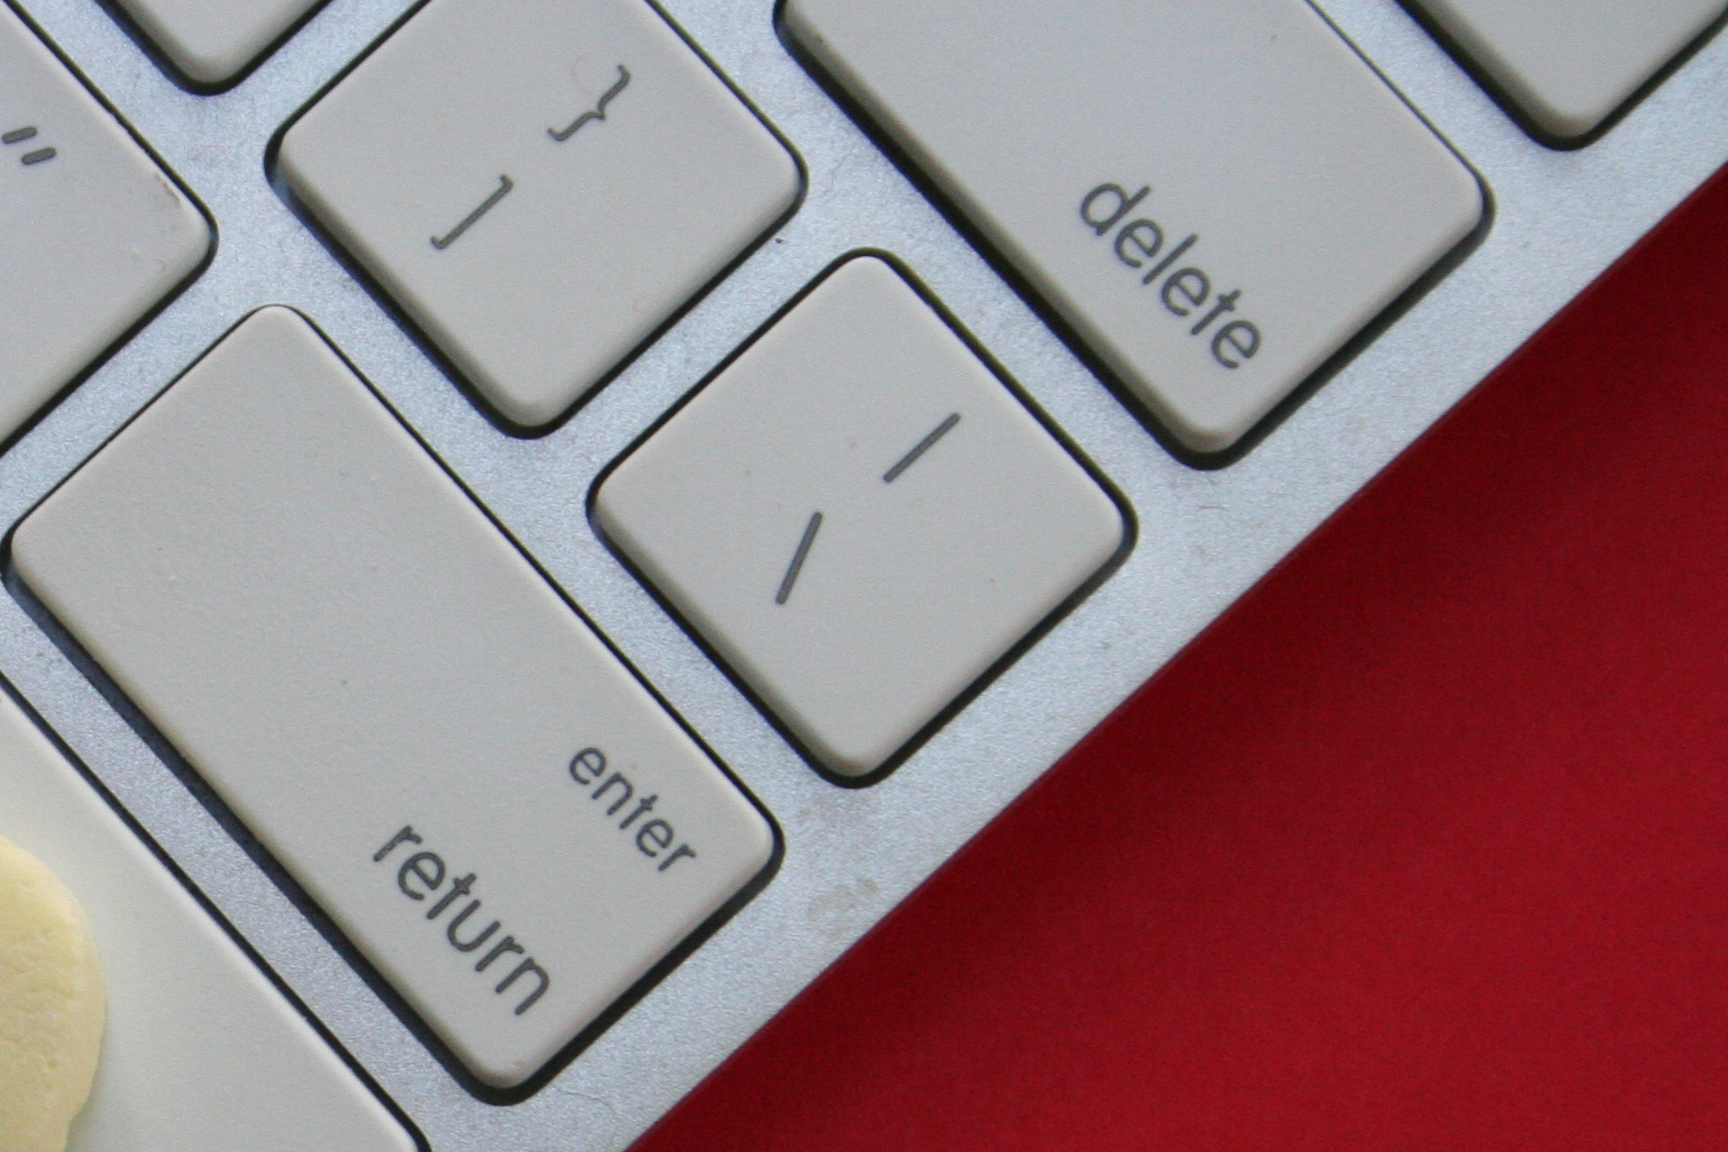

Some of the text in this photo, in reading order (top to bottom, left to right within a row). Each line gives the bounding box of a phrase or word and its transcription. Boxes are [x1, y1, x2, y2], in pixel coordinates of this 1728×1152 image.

[1080, 180, 1263, 371] delete
[567, 745, 697, 873] enter
[372, 823, 552, 1018] return
